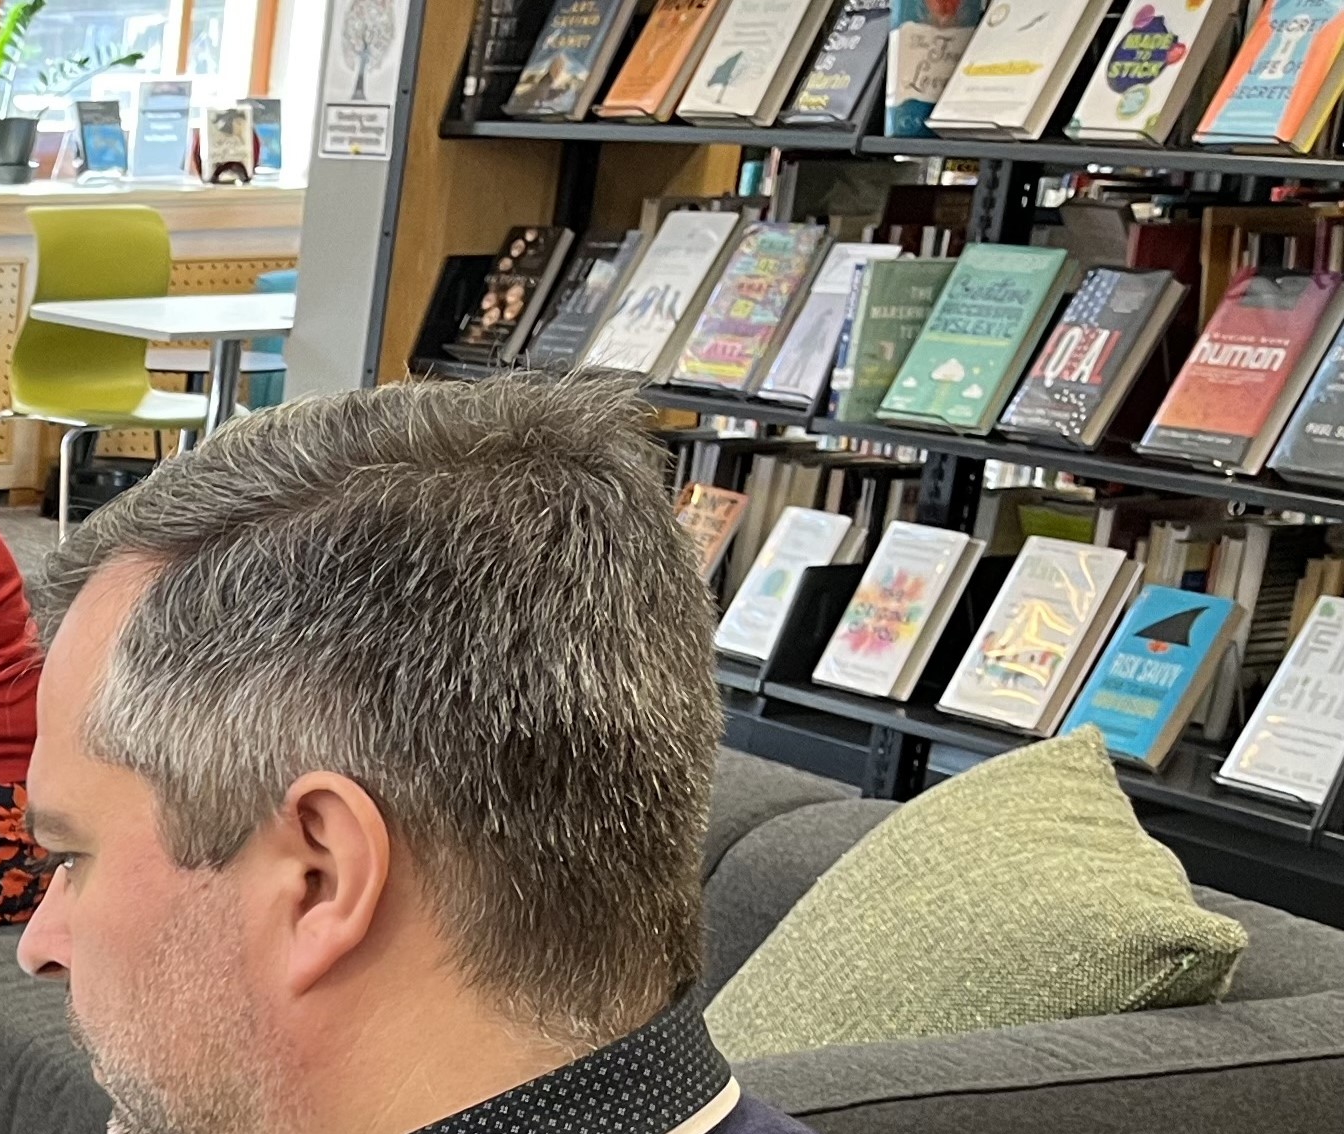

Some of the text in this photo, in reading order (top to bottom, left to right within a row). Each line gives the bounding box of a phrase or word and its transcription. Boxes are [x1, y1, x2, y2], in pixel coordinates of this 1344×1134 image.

[1122, 31, 1174, 50] MADE
[1107, 60, 1164, 79] STICK
[1189, 333, 1287, 372] human
[1108, 652, 1143, 680] RISK
